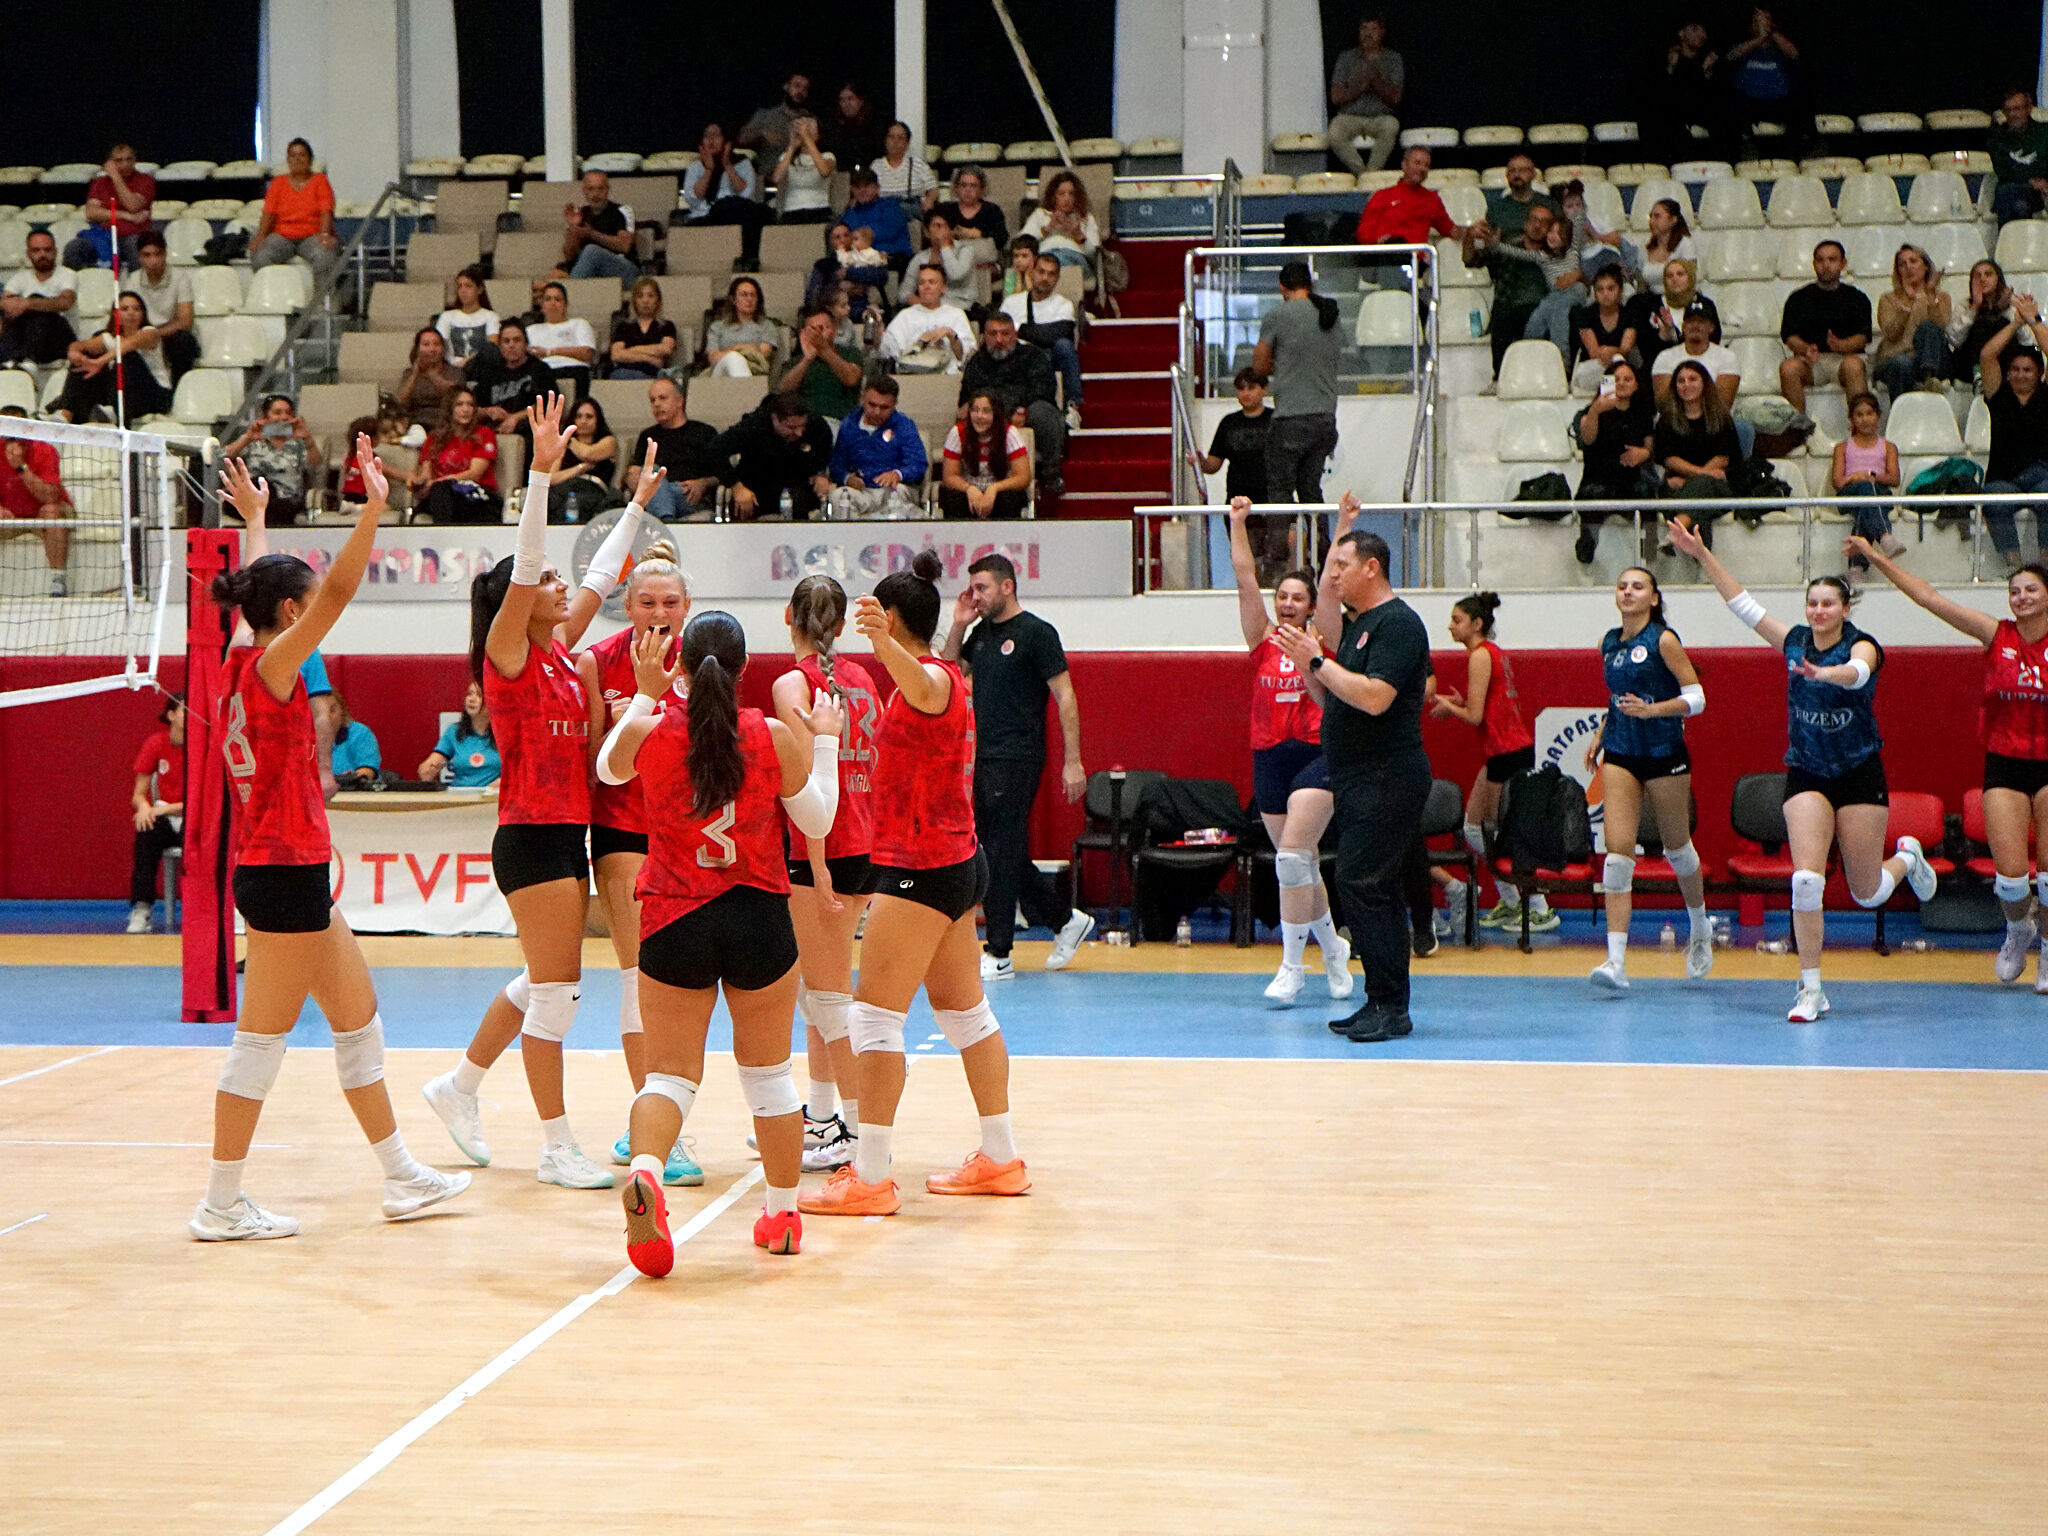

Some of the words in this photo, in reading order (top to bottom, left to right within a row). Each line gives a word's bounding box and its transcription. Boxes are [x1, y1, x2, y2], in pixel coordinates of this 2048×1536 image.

[2018, 661, 2044, 689] 21
[696, 800, 737, 868] 3
[360, 853, 495, 904] TVF
